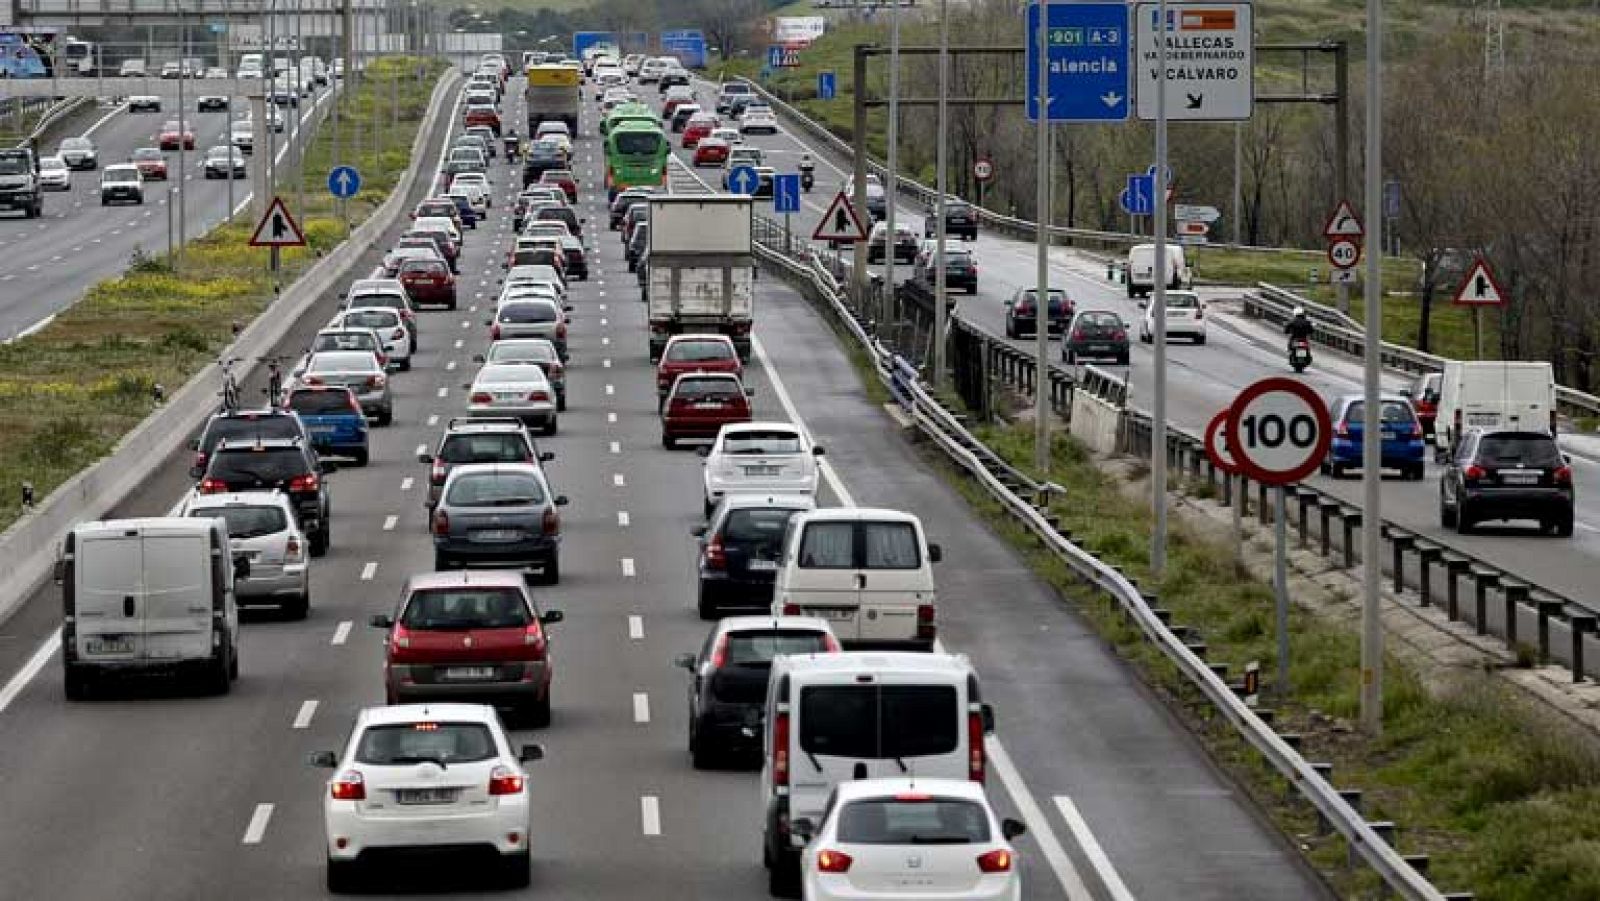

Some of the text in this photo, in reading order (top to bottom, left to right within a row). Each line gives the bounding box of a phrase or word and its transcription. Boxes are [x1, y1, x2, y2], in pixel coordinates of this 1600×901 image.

[1048, 30, 1118, 43] -901 A-3
[1047, 56, 1118, 73] alencia
[1335, 247, 1353, 259] 40
[1243, 414, 1316, 449] 100
